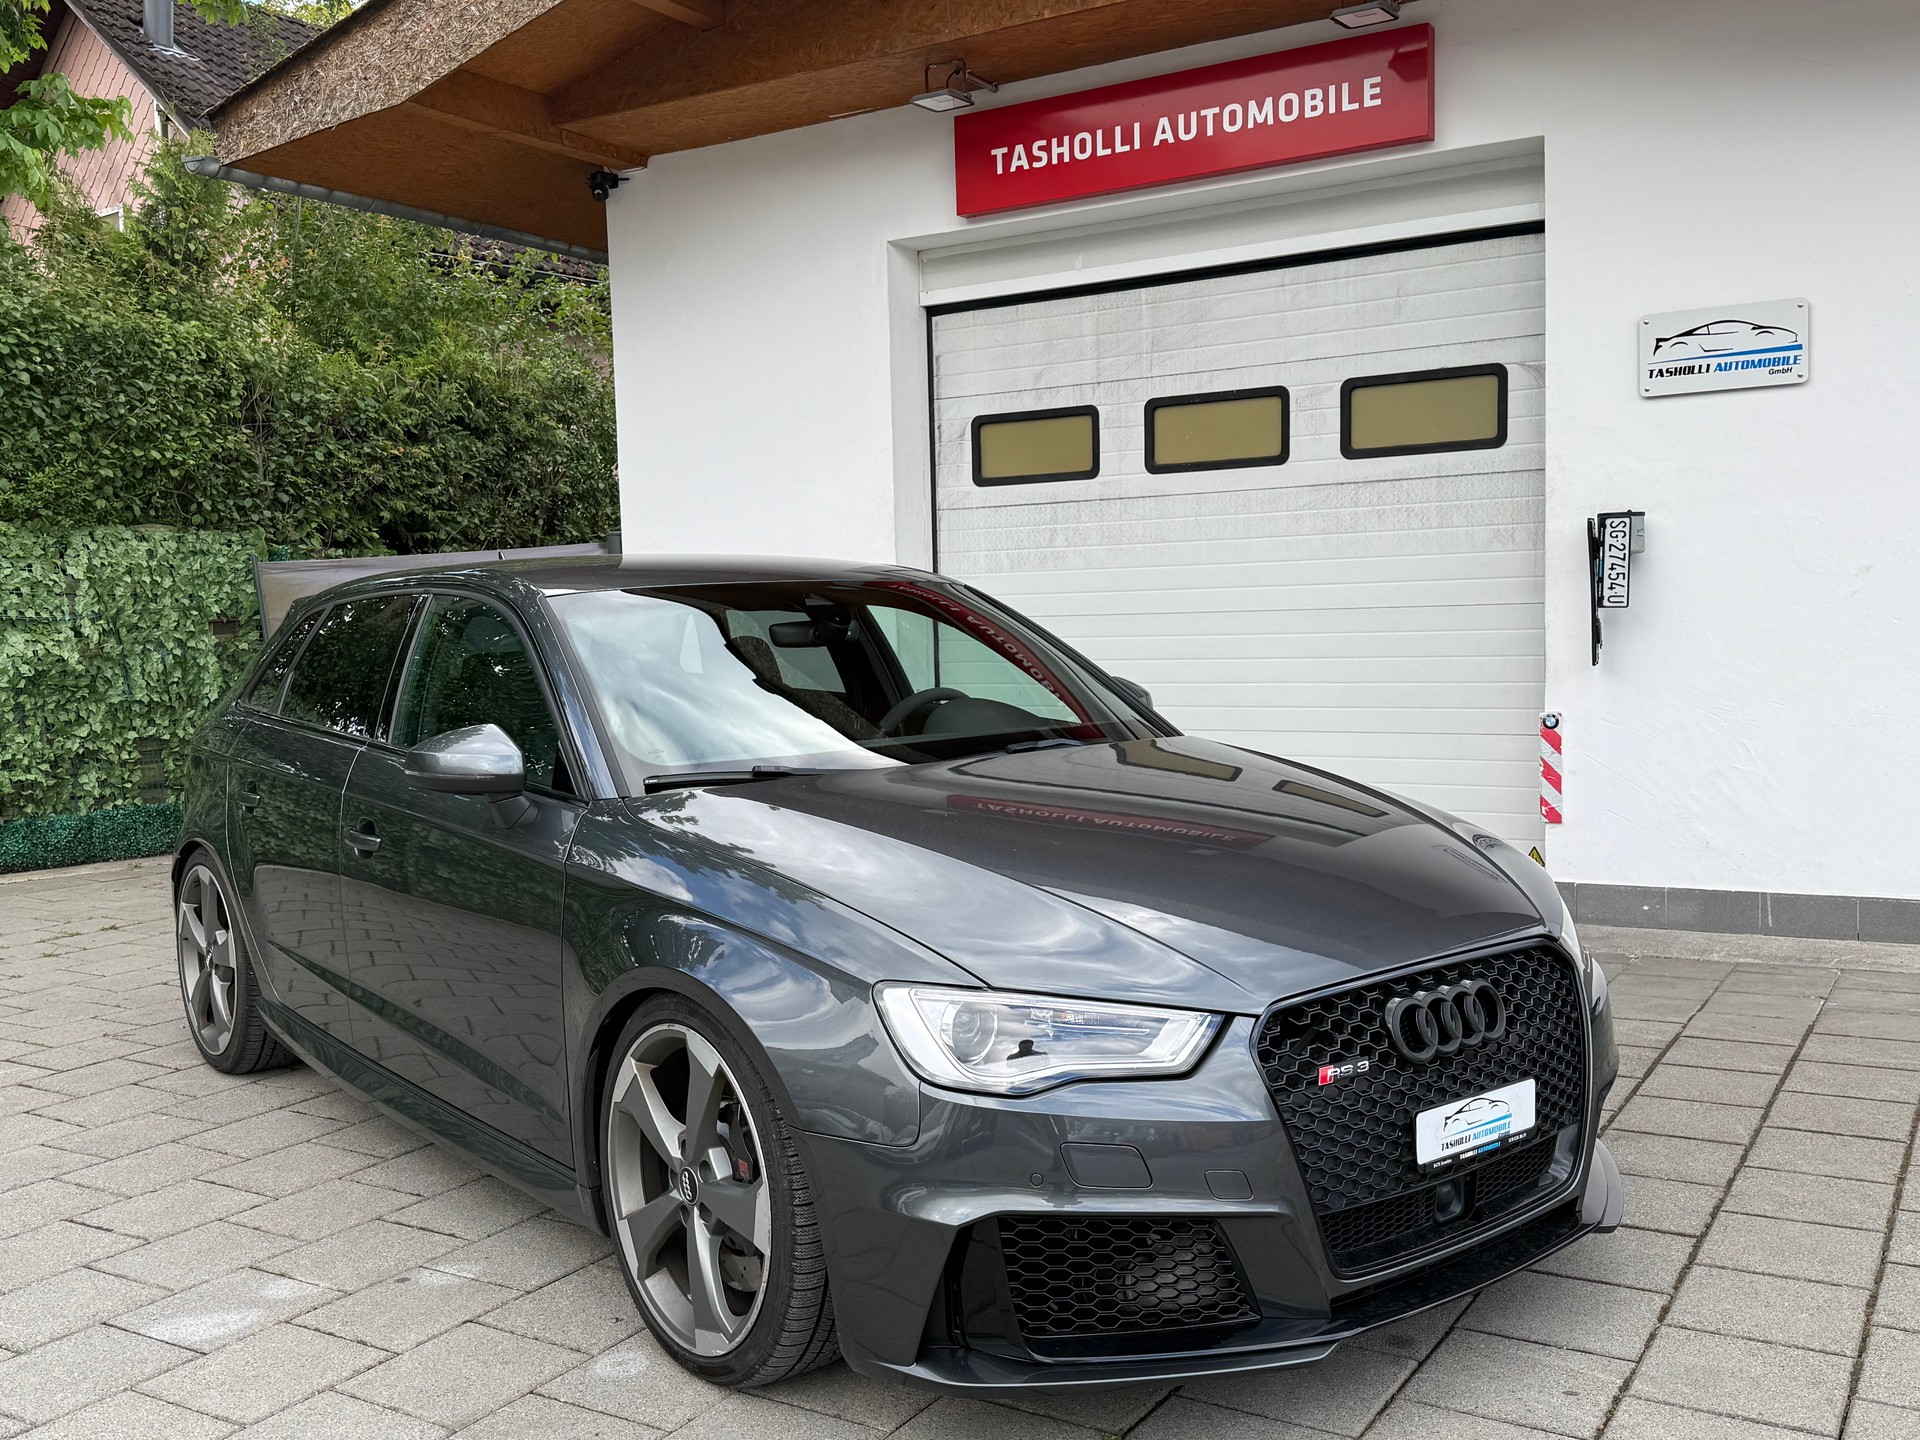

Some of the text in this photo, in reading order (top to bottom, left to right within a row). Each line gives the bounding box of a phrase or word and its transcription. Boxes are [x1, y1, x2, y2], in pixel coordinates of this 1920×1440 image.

[991, 76, 1382, 175] TASHOLLI AUTOMOBILE
[1648, 355, 1802, 379] TASHOLLI AUTOMOBILE
[1768, 366, 1793, 376] GmbH
[1441, 1134, 1471, 1151] TASHOLLI
[1473, 1121, 1511, 1140] AUTOMOBILE
